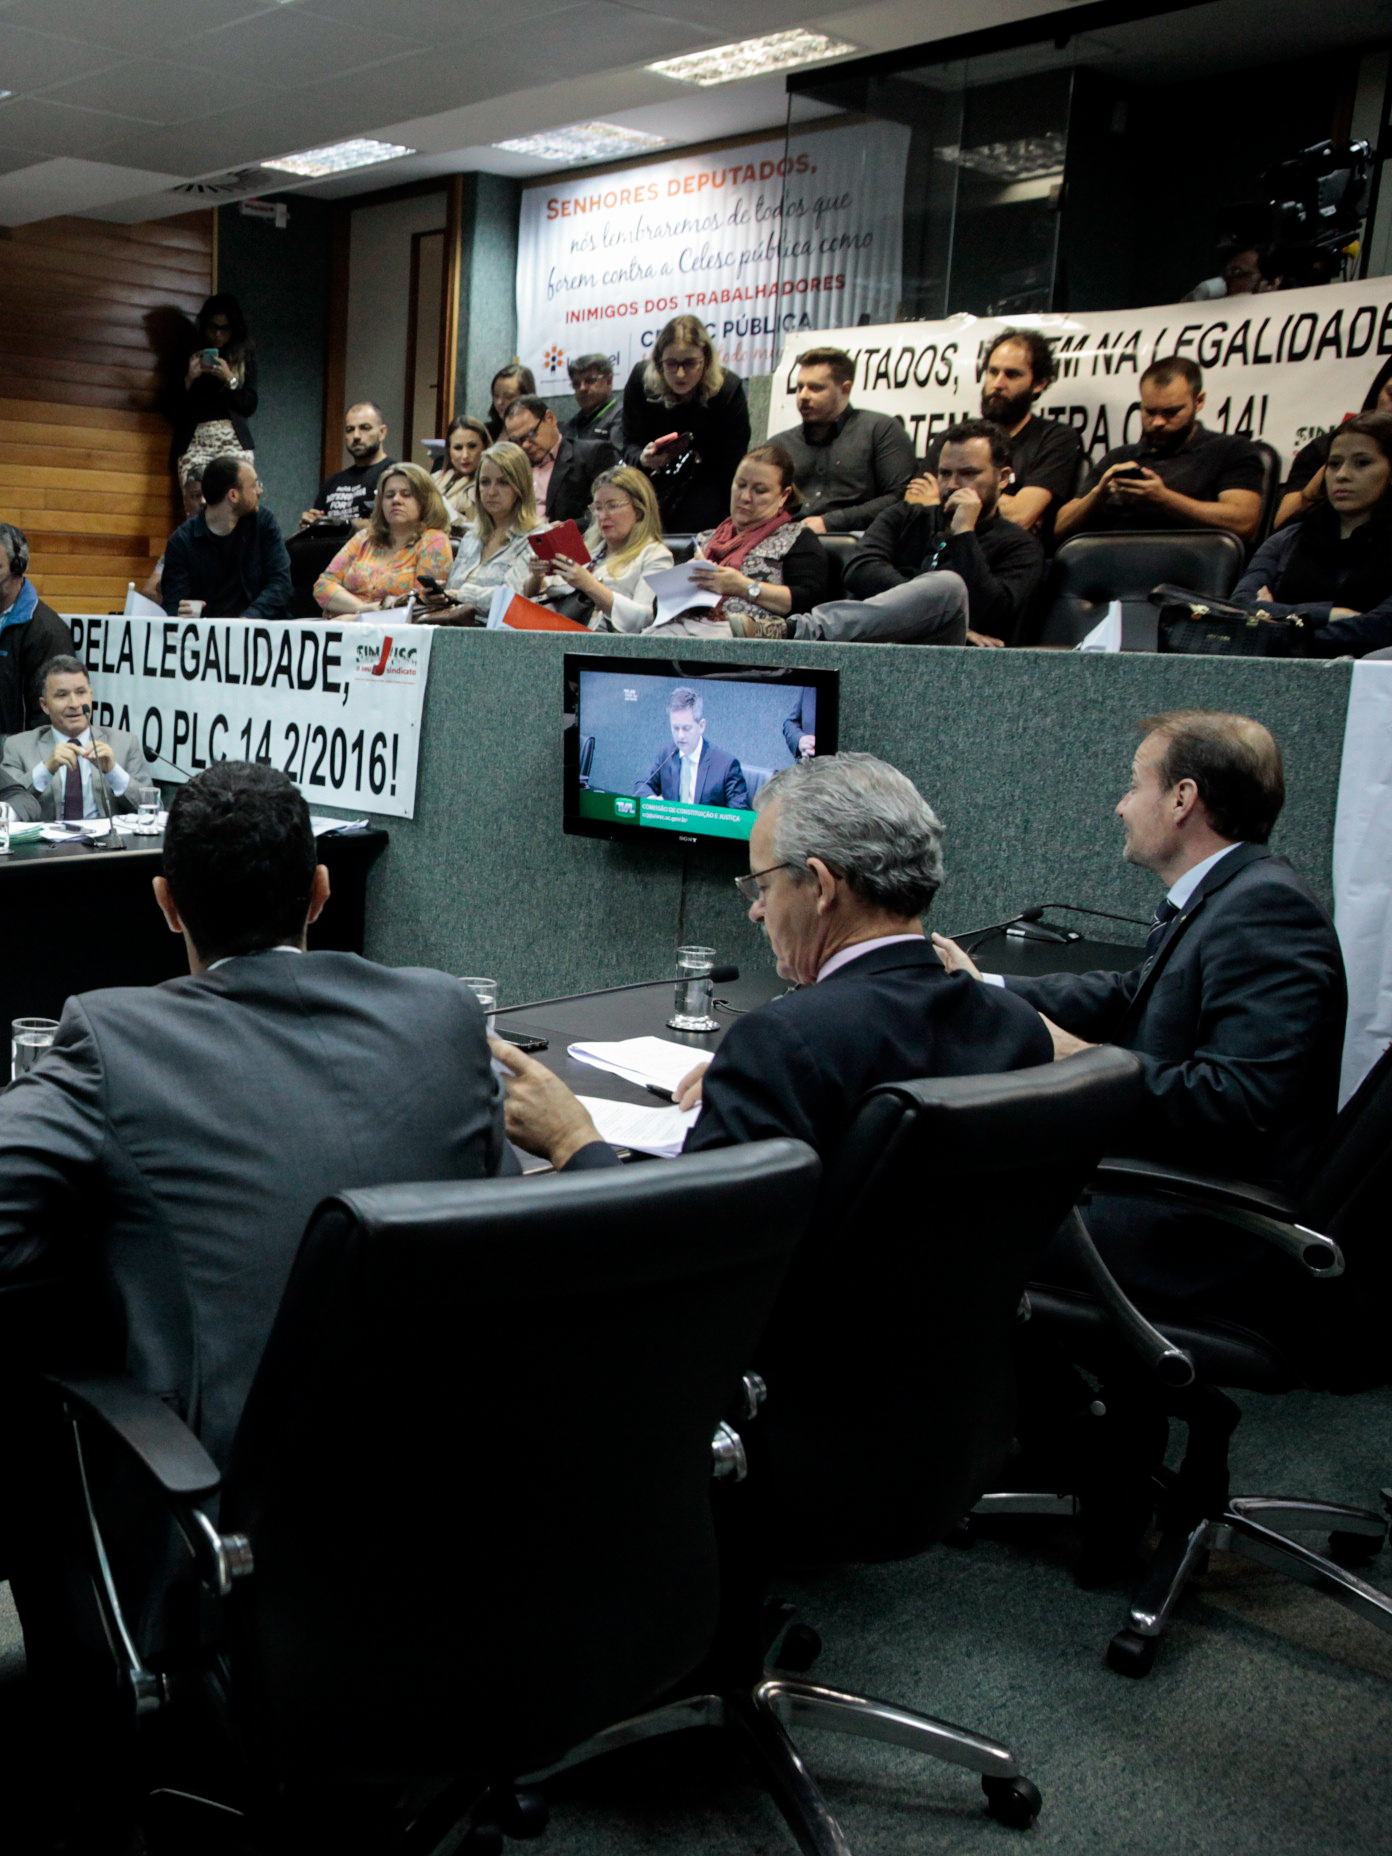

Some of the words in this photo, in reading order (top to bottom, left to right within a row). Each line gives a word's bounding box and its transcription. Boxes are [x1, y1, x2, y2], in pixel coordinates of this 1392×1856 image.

[546, 183, 659, 220] SENHORES
[570, 228, 598, 254] nós
[603, 212, 724, 246] lembraremos
[727, 198, 752, 224] de
[754, 189, 810, 223] todos
[812, 192, 853, 230] que
[547, 266, 598, 301] forem
[602, 255, 657, 286] contra
[660, 262, 674, 276] a
[678, 241, 737, 275] Celesc
[737, 229, 817, 280] pública
[818, 231, 874, 254] como
[565, 301, 640, 325] INIMIGOS
[644, 295, 679, 314] DOS
[685, 273, 846, 308] TRABALHADORES
[723, 311, 812, 339] PÚBLICA
[786, 343, 959, 395] DTADOS,
[1092, 329, 1143, 376] NA
[71, 618, 134, 675] PELA
[143, 621, 350, 707] LEGALIDADE,
[386, 667, 416, 676] sindicato
[142, 706, 163, 763] O
[173, 709, 229, 769] PLC
